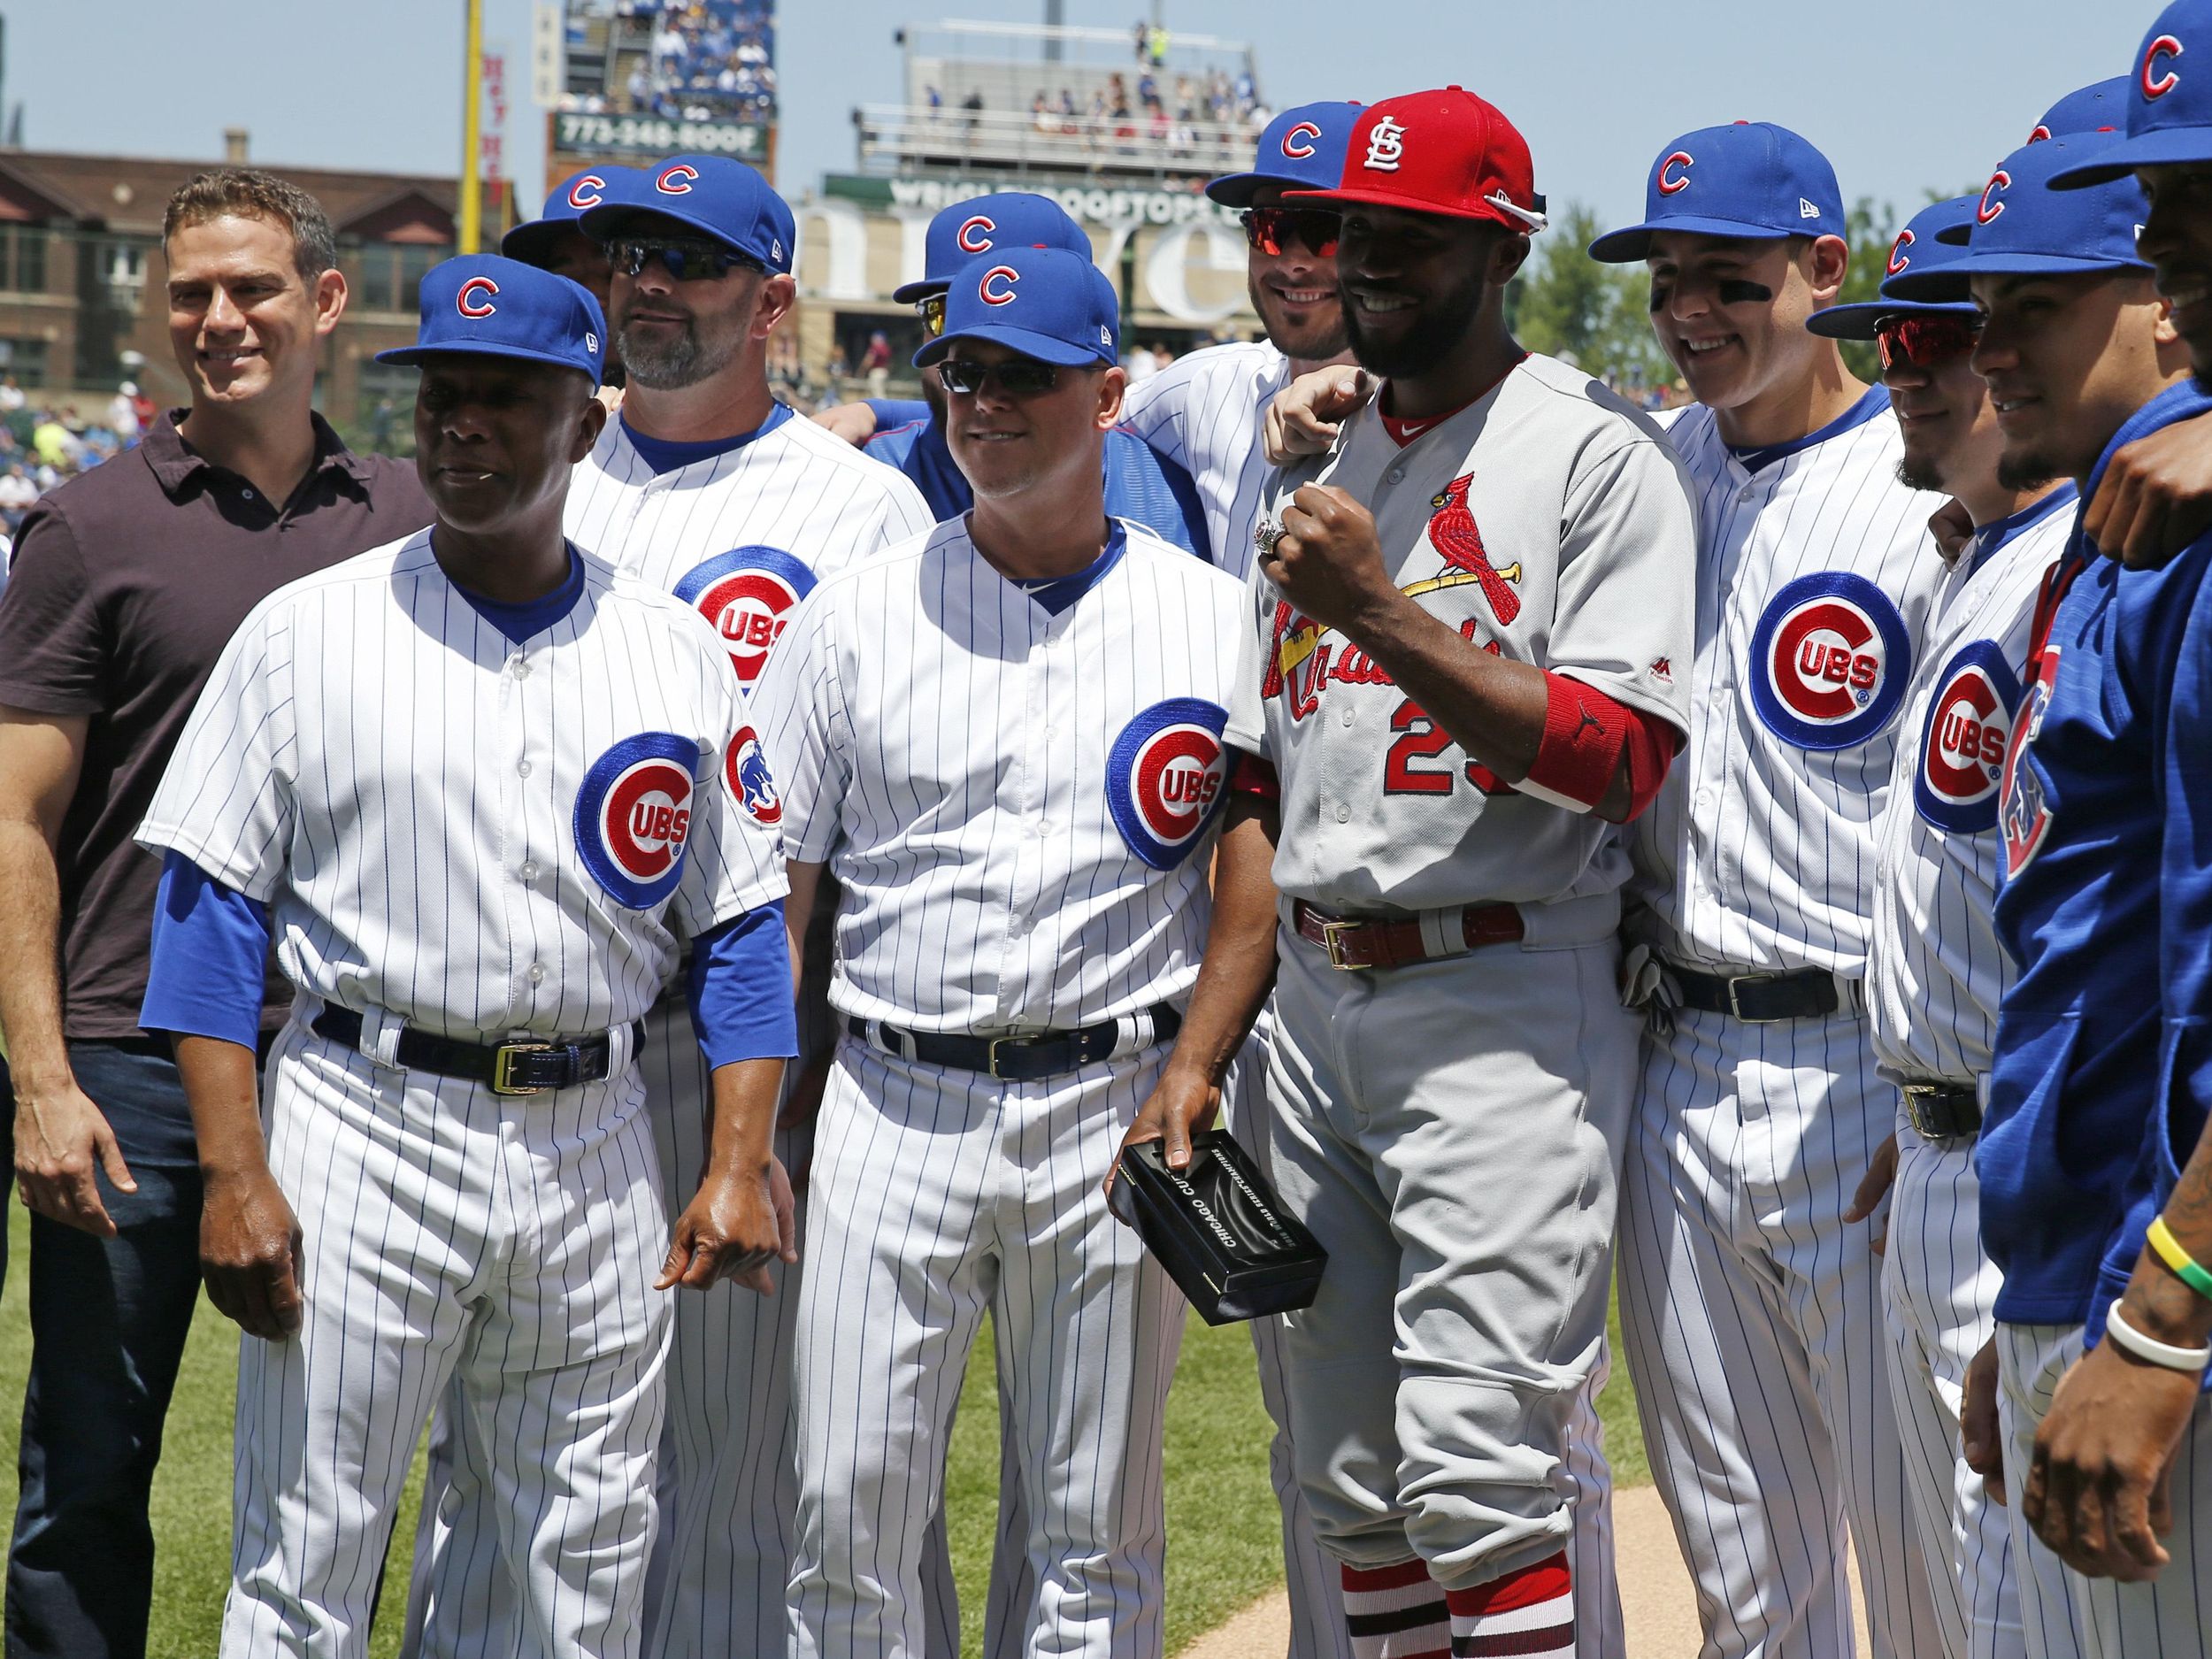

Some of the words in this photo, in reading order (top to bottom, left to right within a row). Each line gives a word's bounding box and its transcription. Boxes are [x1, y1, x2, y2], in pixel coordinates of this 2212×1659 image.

[2141, 35, 2185, 101] C
[1281, 121, 1322, 159] C
[568, 175, 606, 210] C
[656, 165, 700, 195] C
[1657, 150, 1694, 196] C
[1978, 170, 2012, 226] C
[957, 215, 996, 253] C
[1887, 229, 1916, 276] C
[456, 276, 500, 319] C
[979, 265, 1020, 306] C
[1211, 1148, 1243, 1187] CHAMPIONS
[1242, 1185, 1264, 1209] SERIES
[1192, 1199, 1237, 1248] CHICAGO
[1259, 1207, 1283, 1233] WORLD
